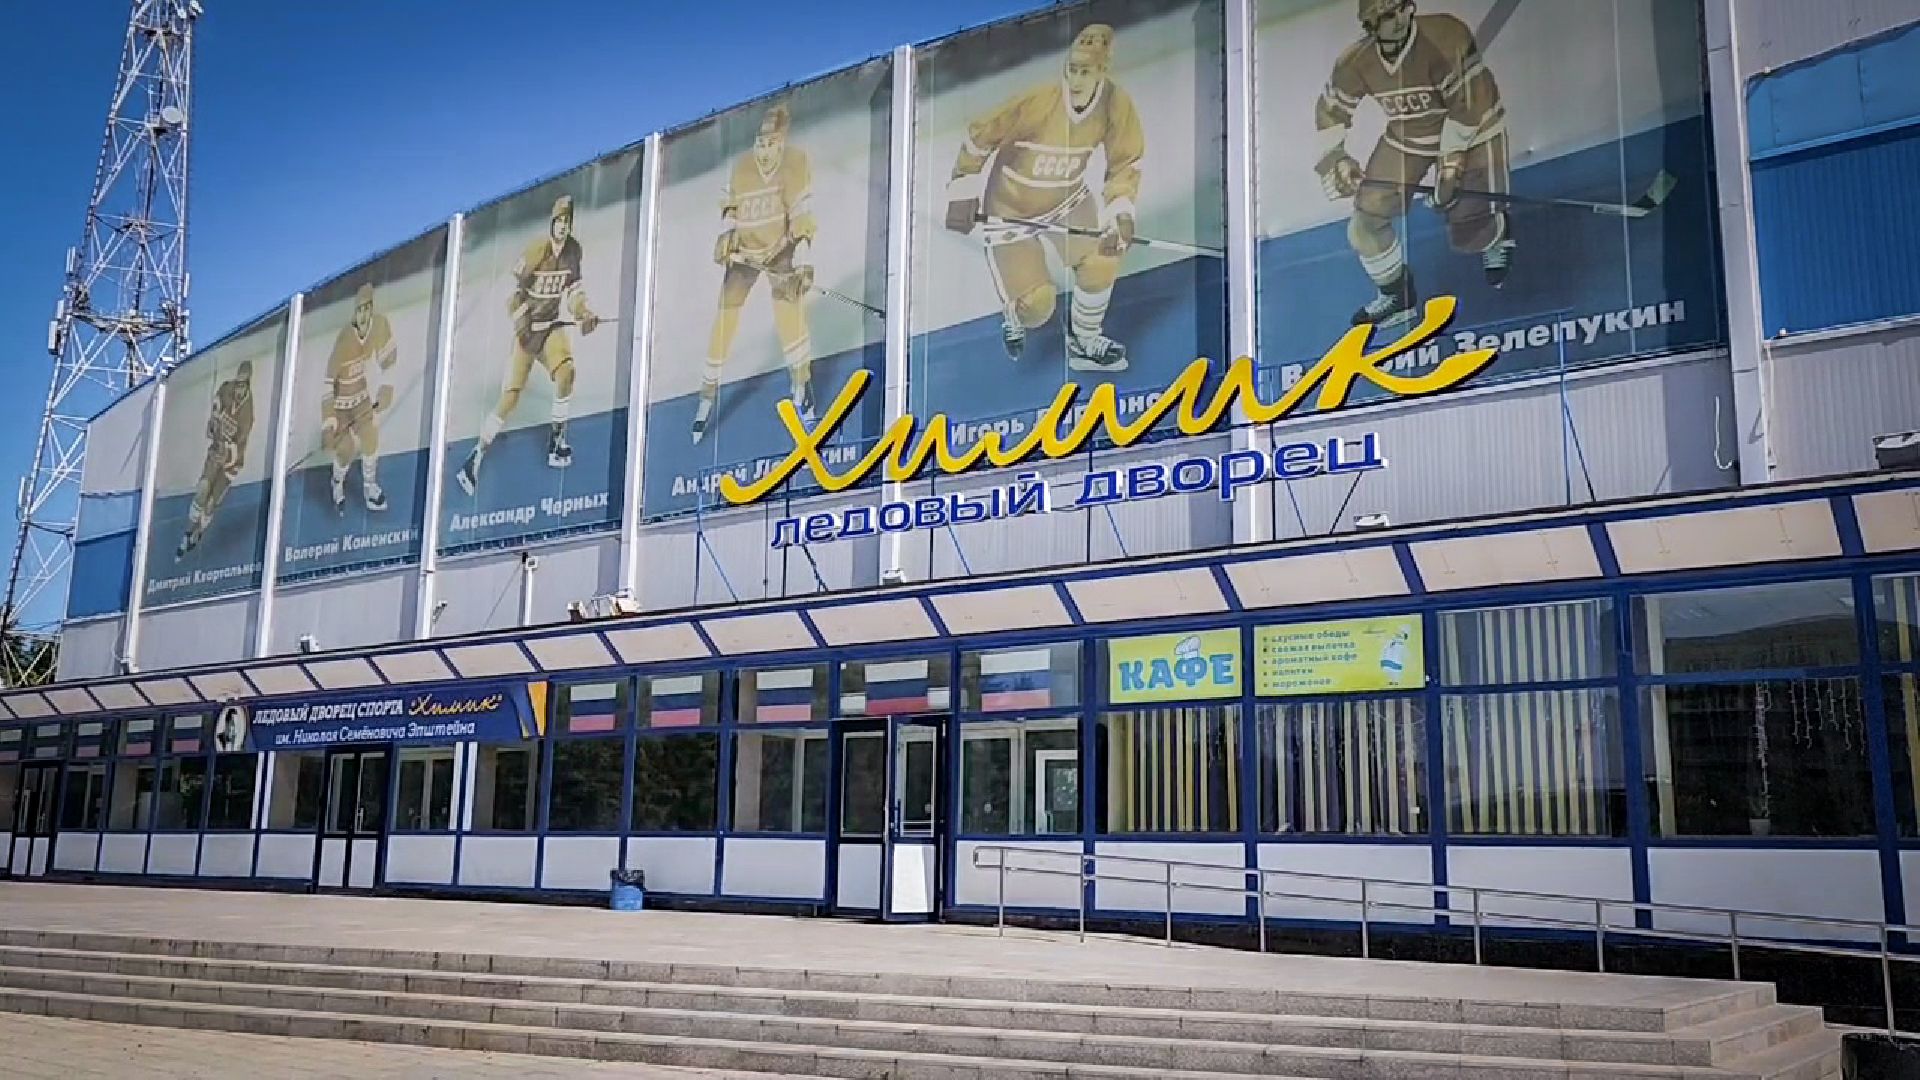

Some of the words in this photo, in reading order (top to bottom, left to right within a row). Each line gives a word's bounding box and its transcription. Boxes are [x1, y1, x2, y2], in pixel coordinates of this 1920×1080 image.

[1382, 92, 1431, 114] СССР
[1032, 154, 1081, 178] СССР
[1455, 299, 1686, 354] Зелепукин
[719, 295, 1498, 505] Химик
[770, 472, 1051, 549] ледовый
[1075, 432, 1387, 506] дворец
[450, 505, 535, 532] Александр
[541, 492, 609, 517] Черных
[285, 537, 340, 562] Валерий
[1118, 653, 1235, 691] КАФЕ
[253, 703, 309, 726] ЛЕДОВЫЙ
[309, 703, 357, 723] ДВОРЕЦ
[357, 699, 403, 718] СПОРТА
[293, 729, 338, 744] Николая
[407, 720, 475, 737] Эпштейна
